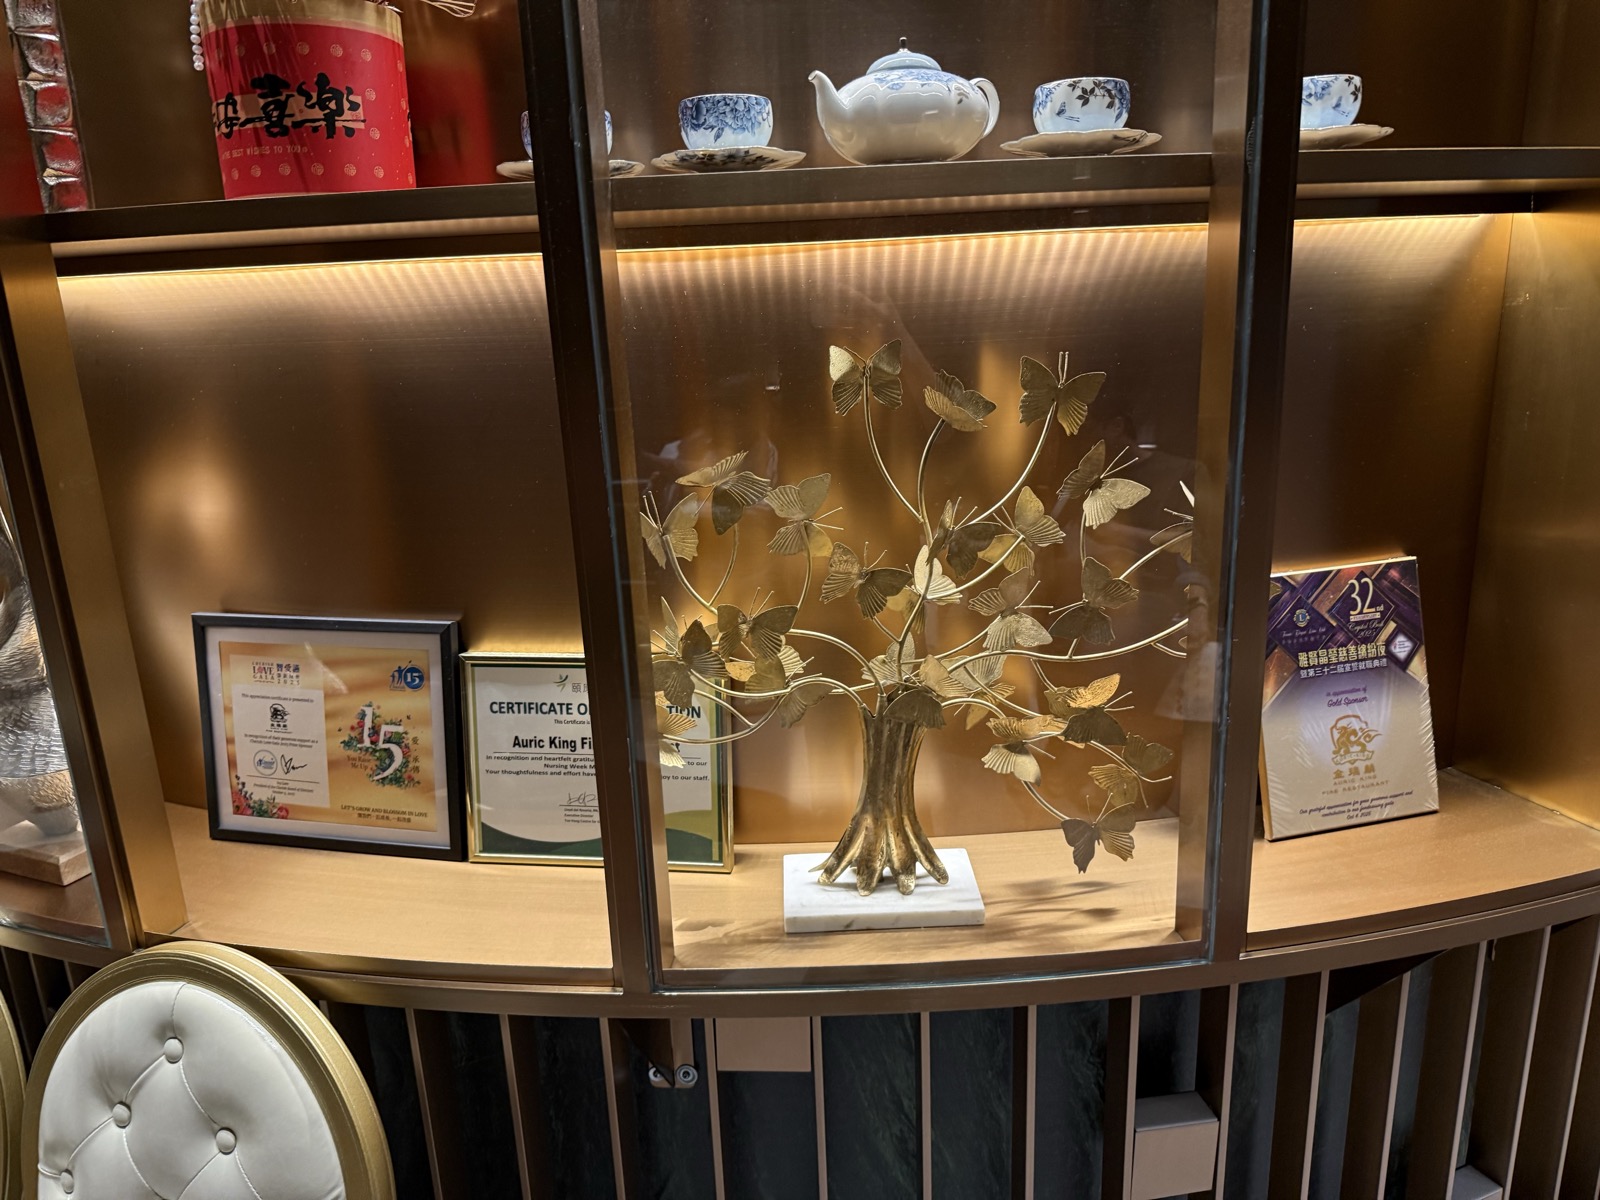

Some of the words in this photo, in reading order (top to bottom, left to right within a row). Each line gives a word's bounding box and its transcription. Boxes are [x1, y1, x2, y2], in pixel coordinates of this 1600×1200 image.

[273, 145, 283, 154] TO
[1327, 698, 1342, 708] Gold
[1343, 696, 1368, 706] Sponsor
[490, 702, 574, 715] CERTIFICATE
[577, 702, 588, 716] O
[357, 706, 404, 780] 15
[512, 736, 545, 748] Auric
[549, 736, 576, 752] King
[581, 736, 592, 750] Fi
[1342, 780, 1389, 792] RESTAURANT
